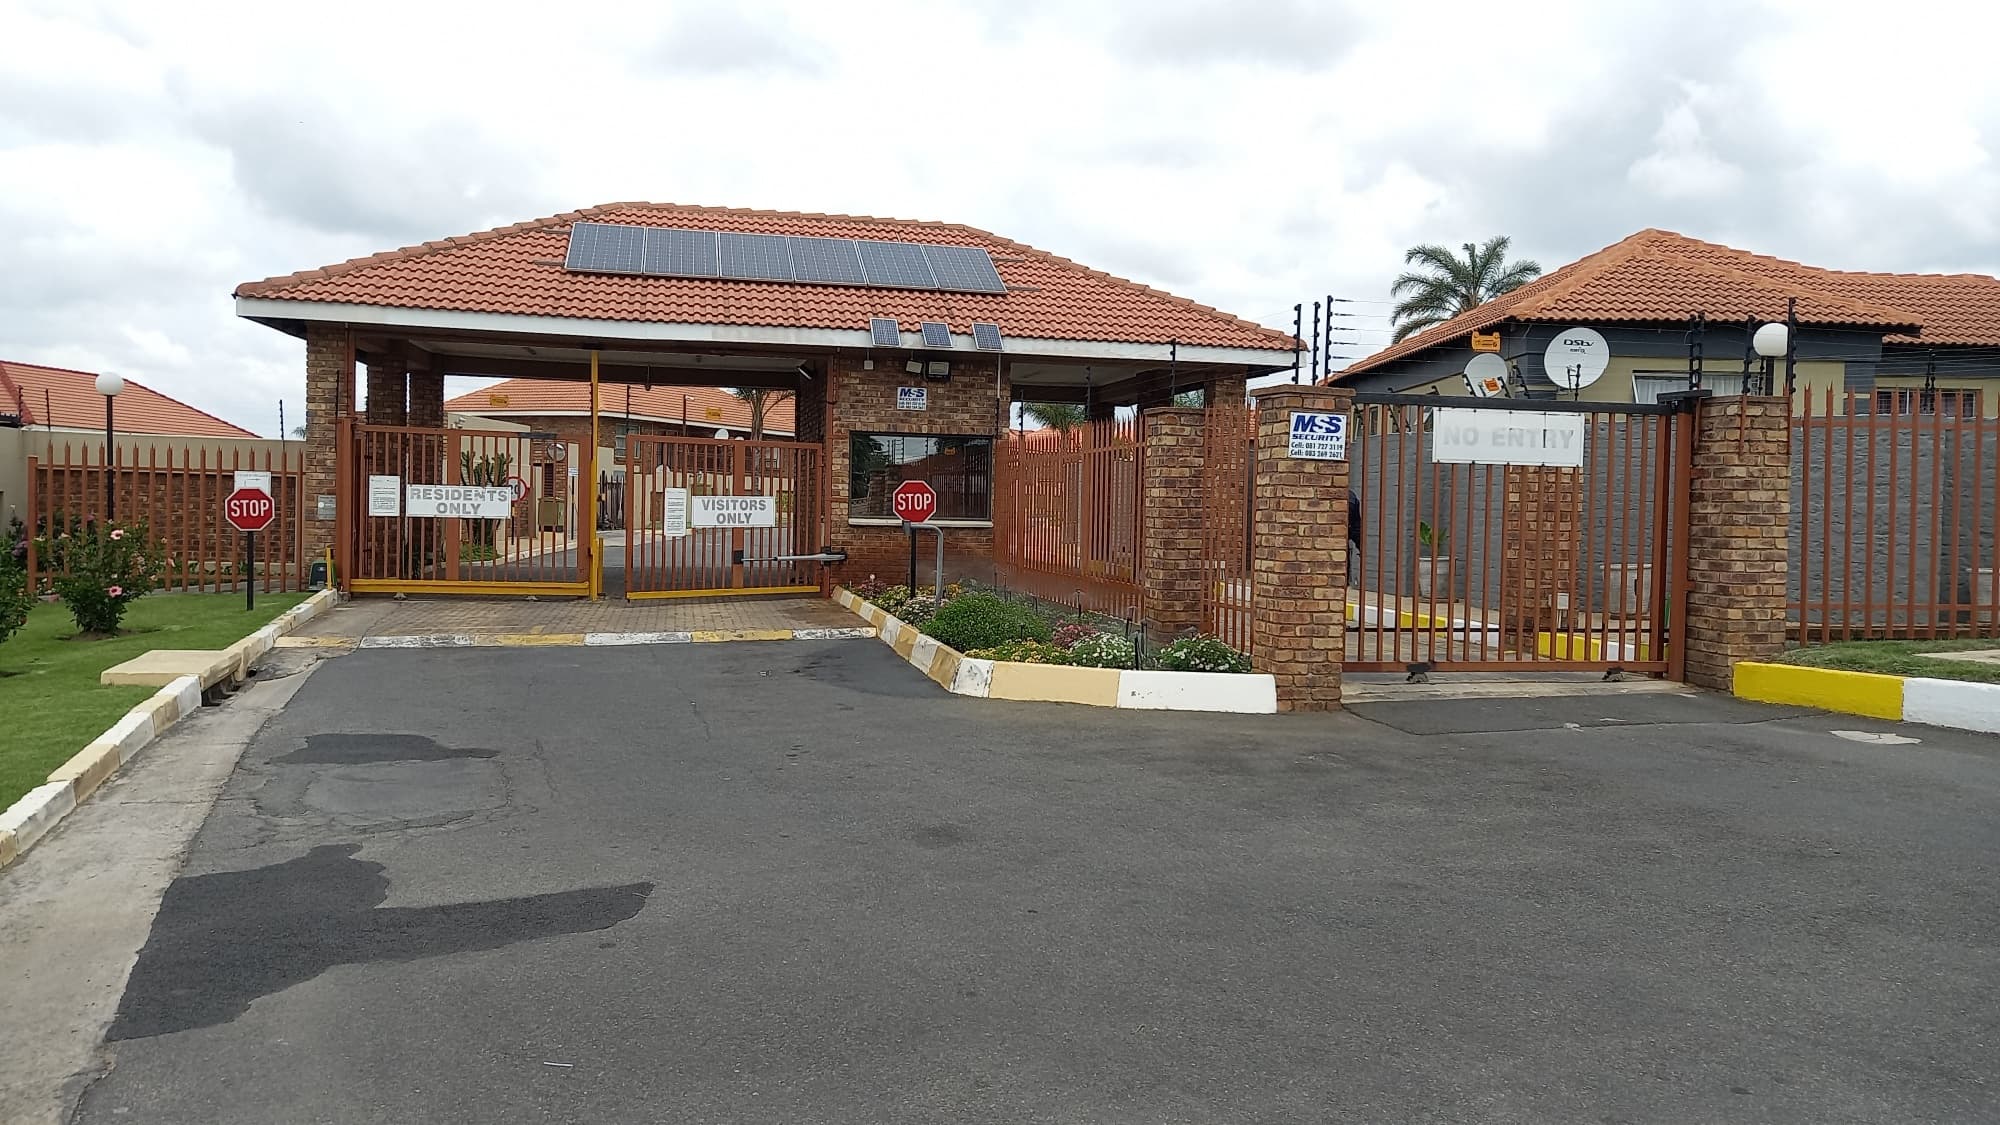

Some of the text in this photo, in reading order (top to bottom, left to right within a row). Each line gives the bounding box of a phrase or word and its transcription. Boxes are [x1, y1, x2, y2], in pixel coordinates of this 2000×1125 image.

[1444, 426, 1574, 448] NO ENTRY
[410, 488, 508, 501] RESIDENTS
[230, 500, 270, 517] STOP
[436, 502, 481, 514] ONLY
[702, 499, 767, 511] VISITORS
[897, 493, 932, 511] STOP
[716, 513, 752, 525] ONLY
